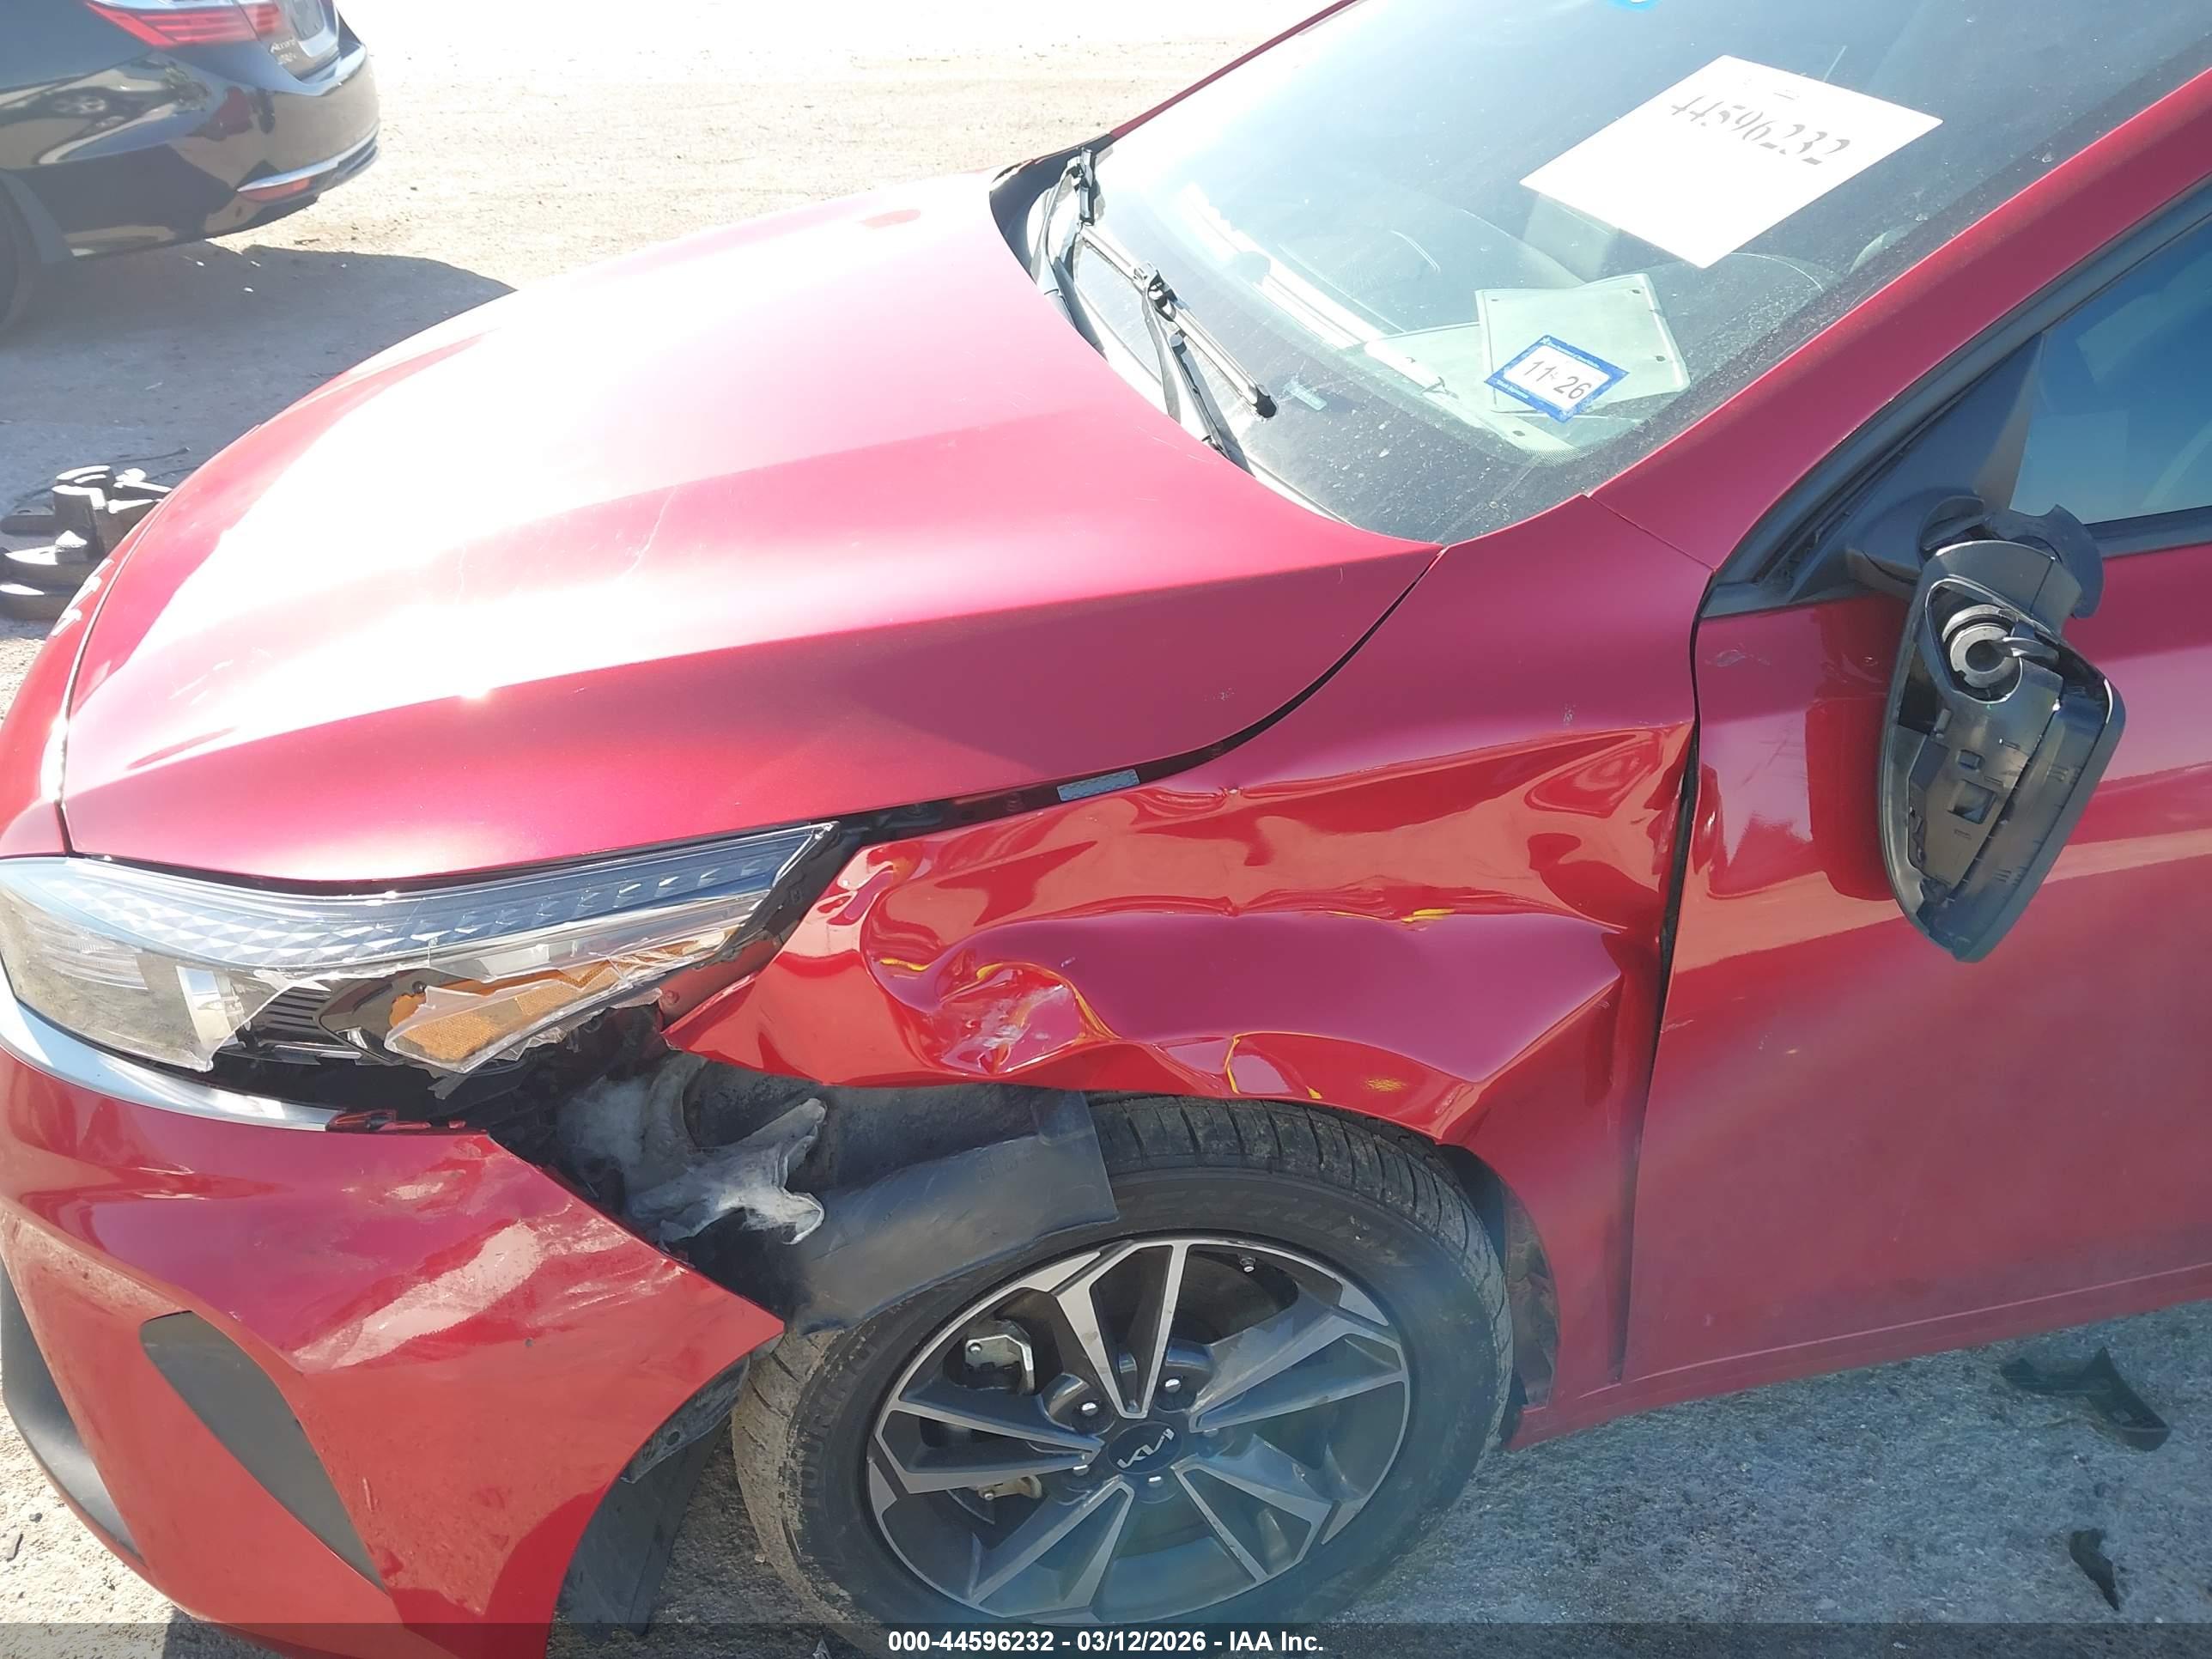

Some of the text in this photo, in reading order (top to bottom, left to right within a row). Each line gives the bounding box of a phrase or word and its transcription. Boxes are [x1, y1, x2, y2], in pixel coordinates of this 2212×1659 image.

[1671, 94, 1851, 166] 44596232
[1523, 360, 1557, 382] 11
[1553, 375, 1593, 400] 26
